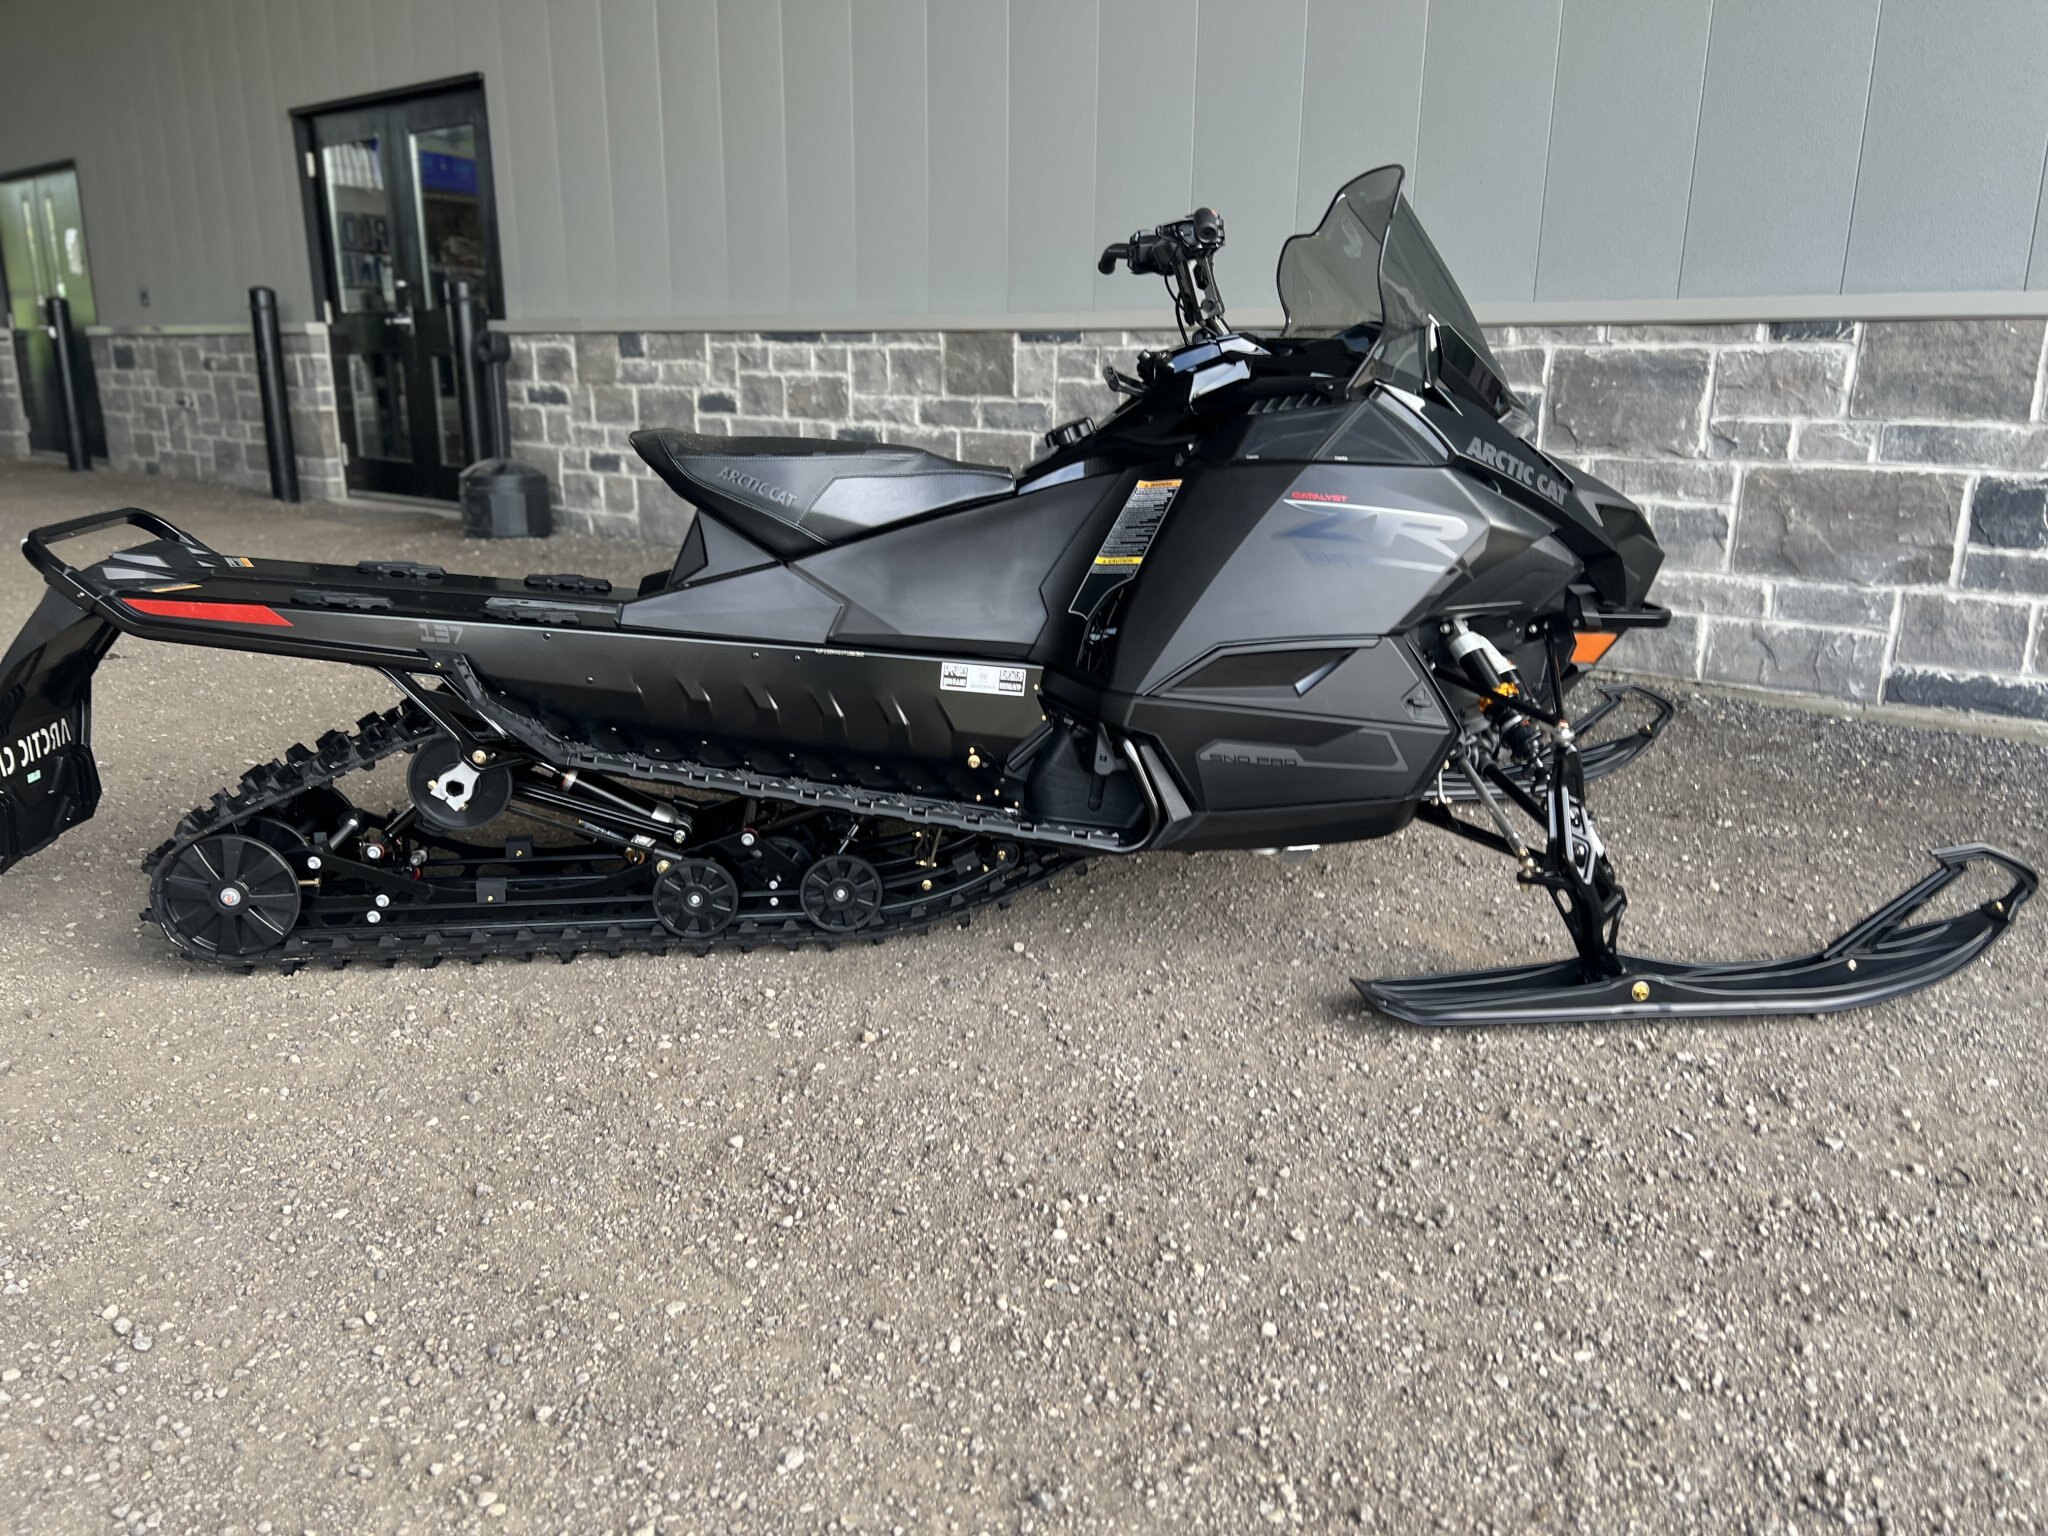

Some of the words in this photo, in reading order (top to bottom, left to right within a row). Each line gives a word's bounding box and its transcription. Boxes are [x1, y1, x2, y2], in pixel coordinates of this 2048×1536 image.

[717, 467, 769, 495] ARCTIC
[768, 487, 797, 507] CAT
[1466, 437, 1534, 486] ARCTIC
[1537, 474, 1567, 506] CAT
[1291, 490, 1348, 502] CATALYST
